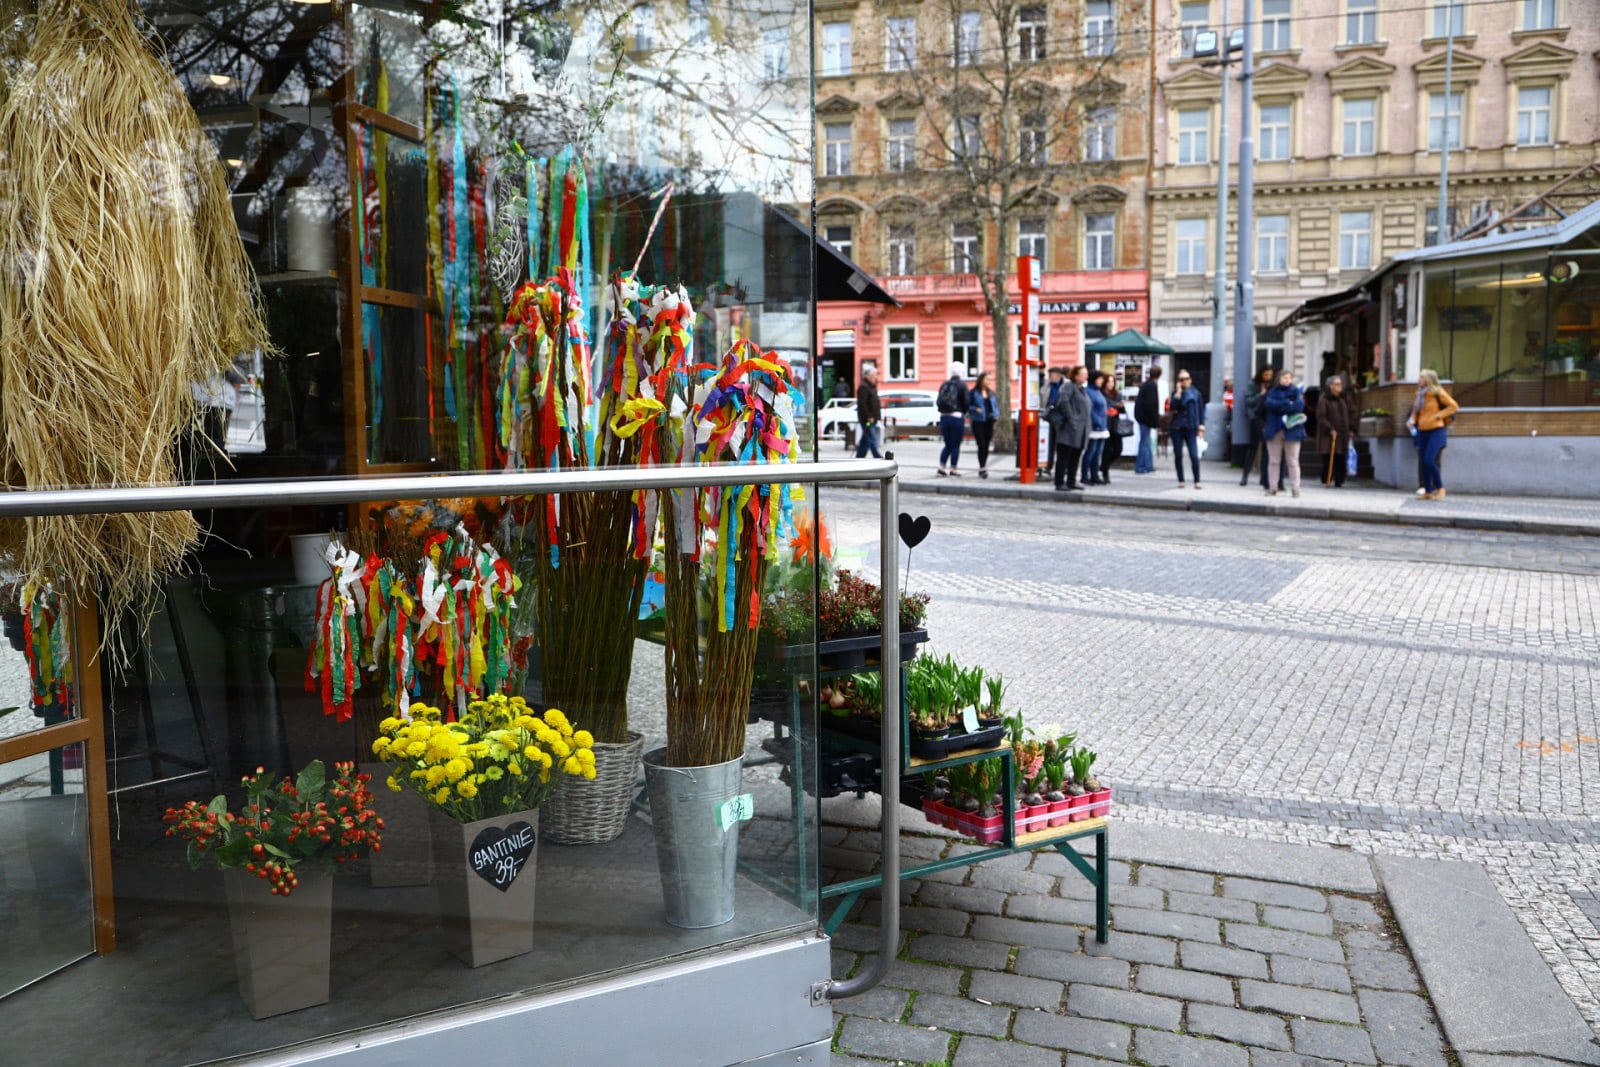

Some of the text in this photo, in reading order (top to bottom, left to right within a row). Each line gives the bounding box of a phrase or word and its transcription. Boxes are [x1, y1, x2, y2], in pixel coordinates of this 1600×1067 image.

[988, 301, 1136, 314] STRANT BAR
[474, 826, 534, 870] SANTINIE
